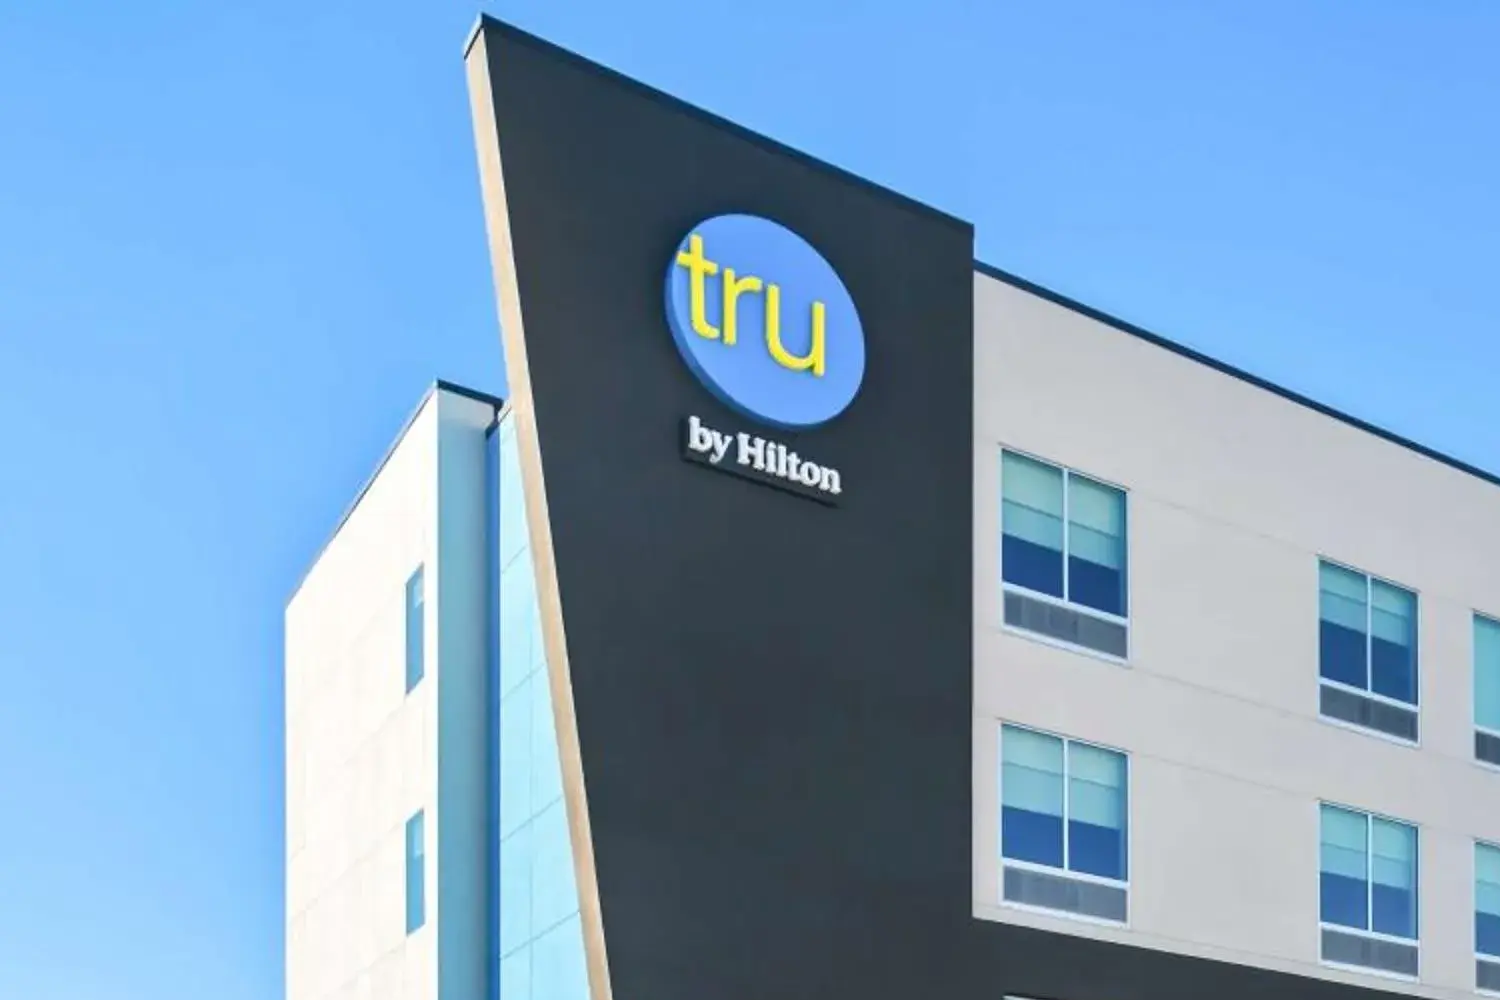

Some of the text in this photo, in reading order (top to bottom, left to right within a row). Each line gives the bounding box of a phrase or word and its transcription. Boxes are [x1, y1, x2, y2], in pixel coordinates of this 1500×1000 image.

[676, 233, 825, 377] tru
[688, 415, 842, 494] by Hilton
